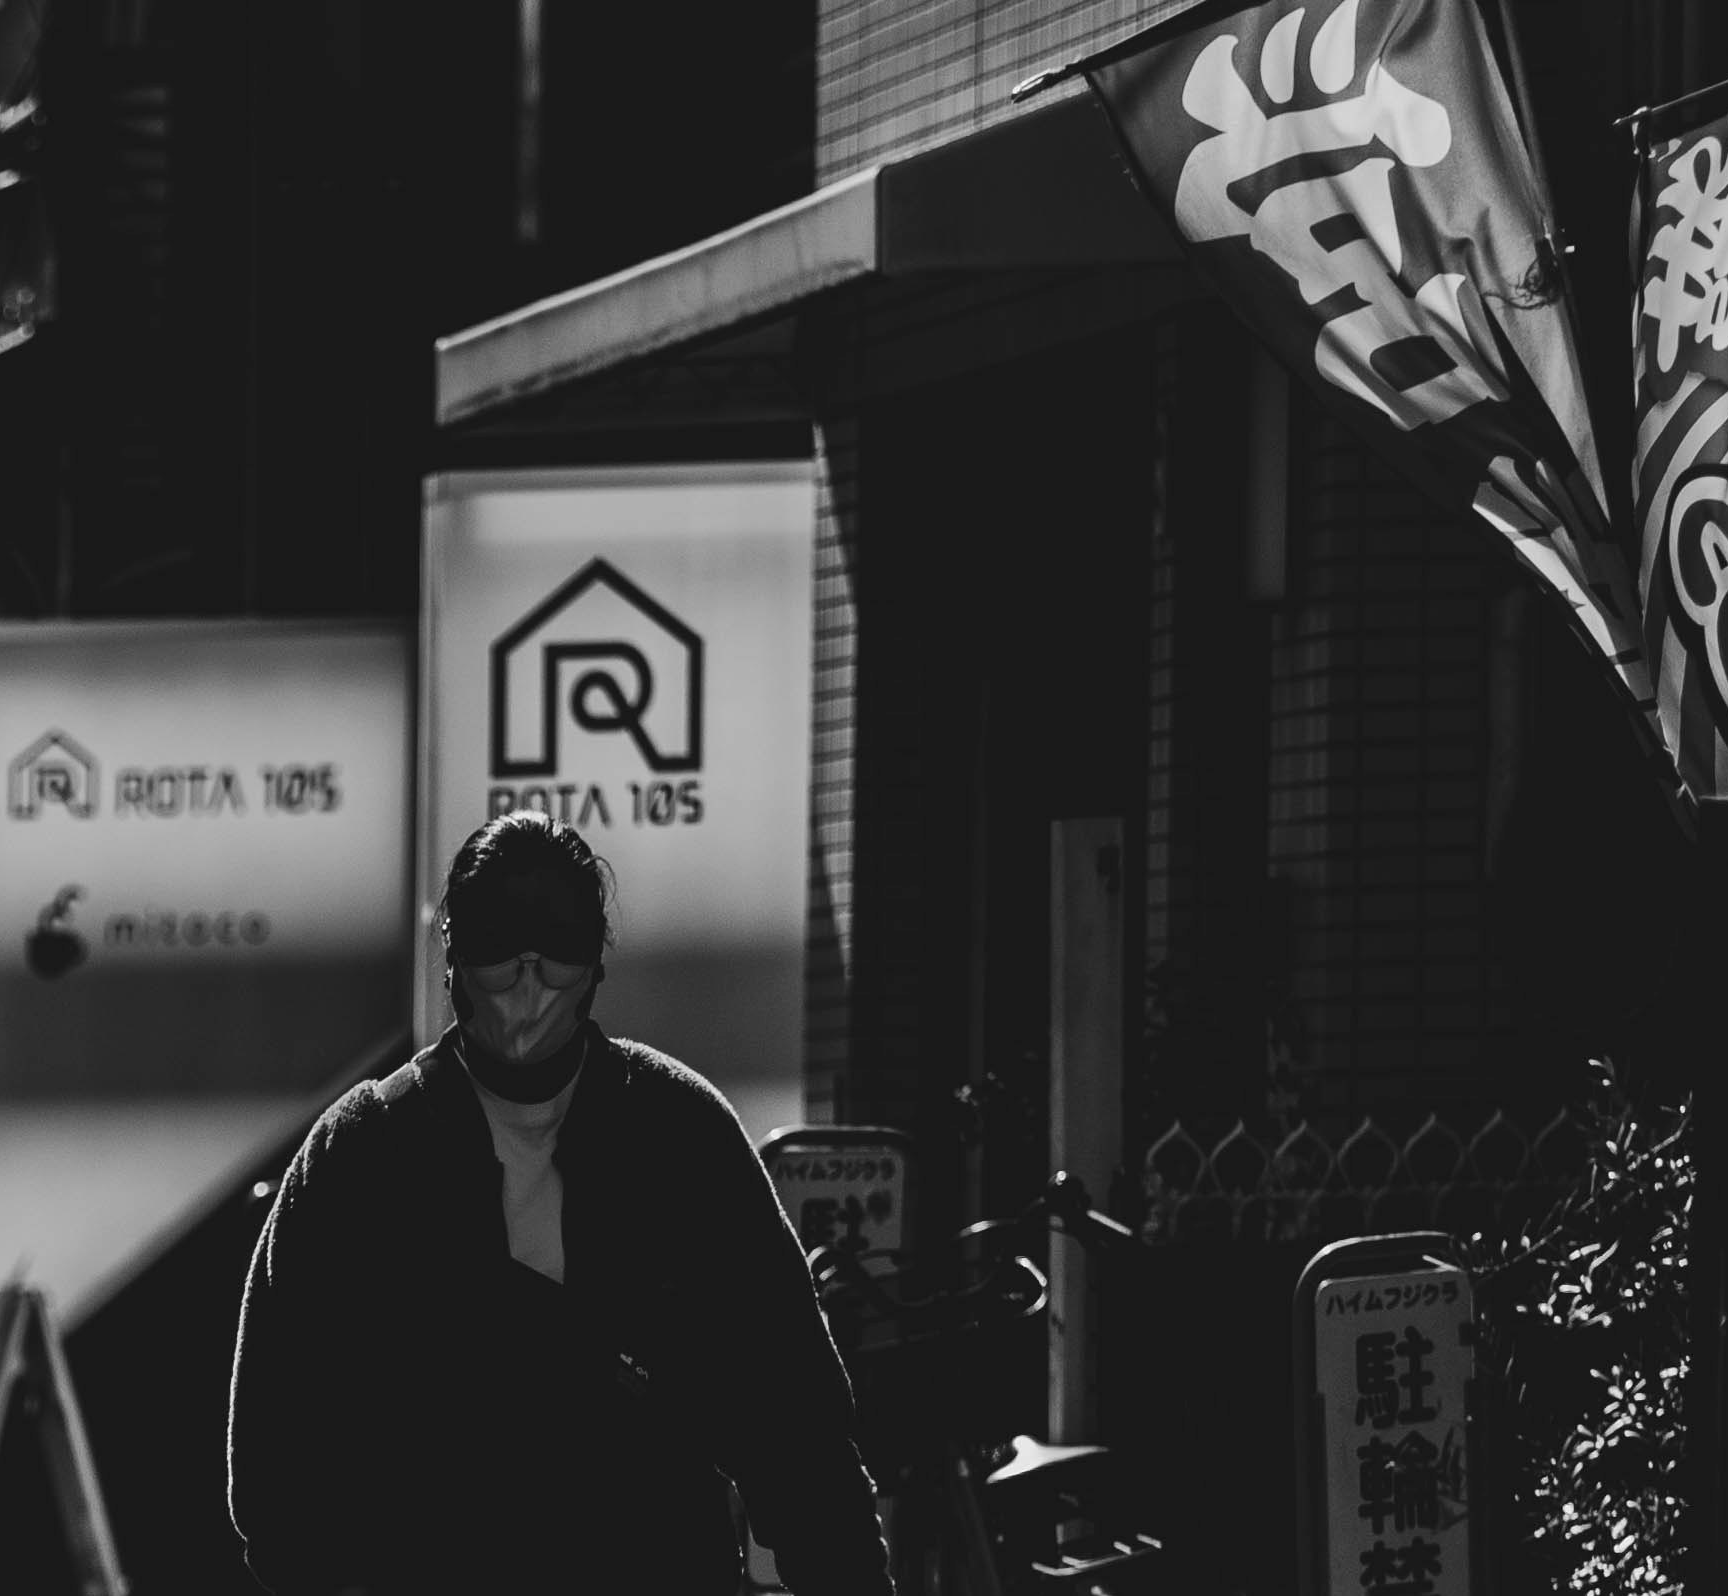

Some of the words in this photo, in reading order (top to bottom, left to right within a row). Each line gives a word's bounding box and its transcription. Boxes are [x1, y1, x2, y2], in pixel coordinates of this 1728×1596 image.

[115, 764, 246, 820] ROTA
[262, 762, 342, 816] 105
[489, 784, 612, 830] ROTA
[628, 779, 705, 828] 105
[1325, 1281, 1460, 1316] ハイムフジクラ
